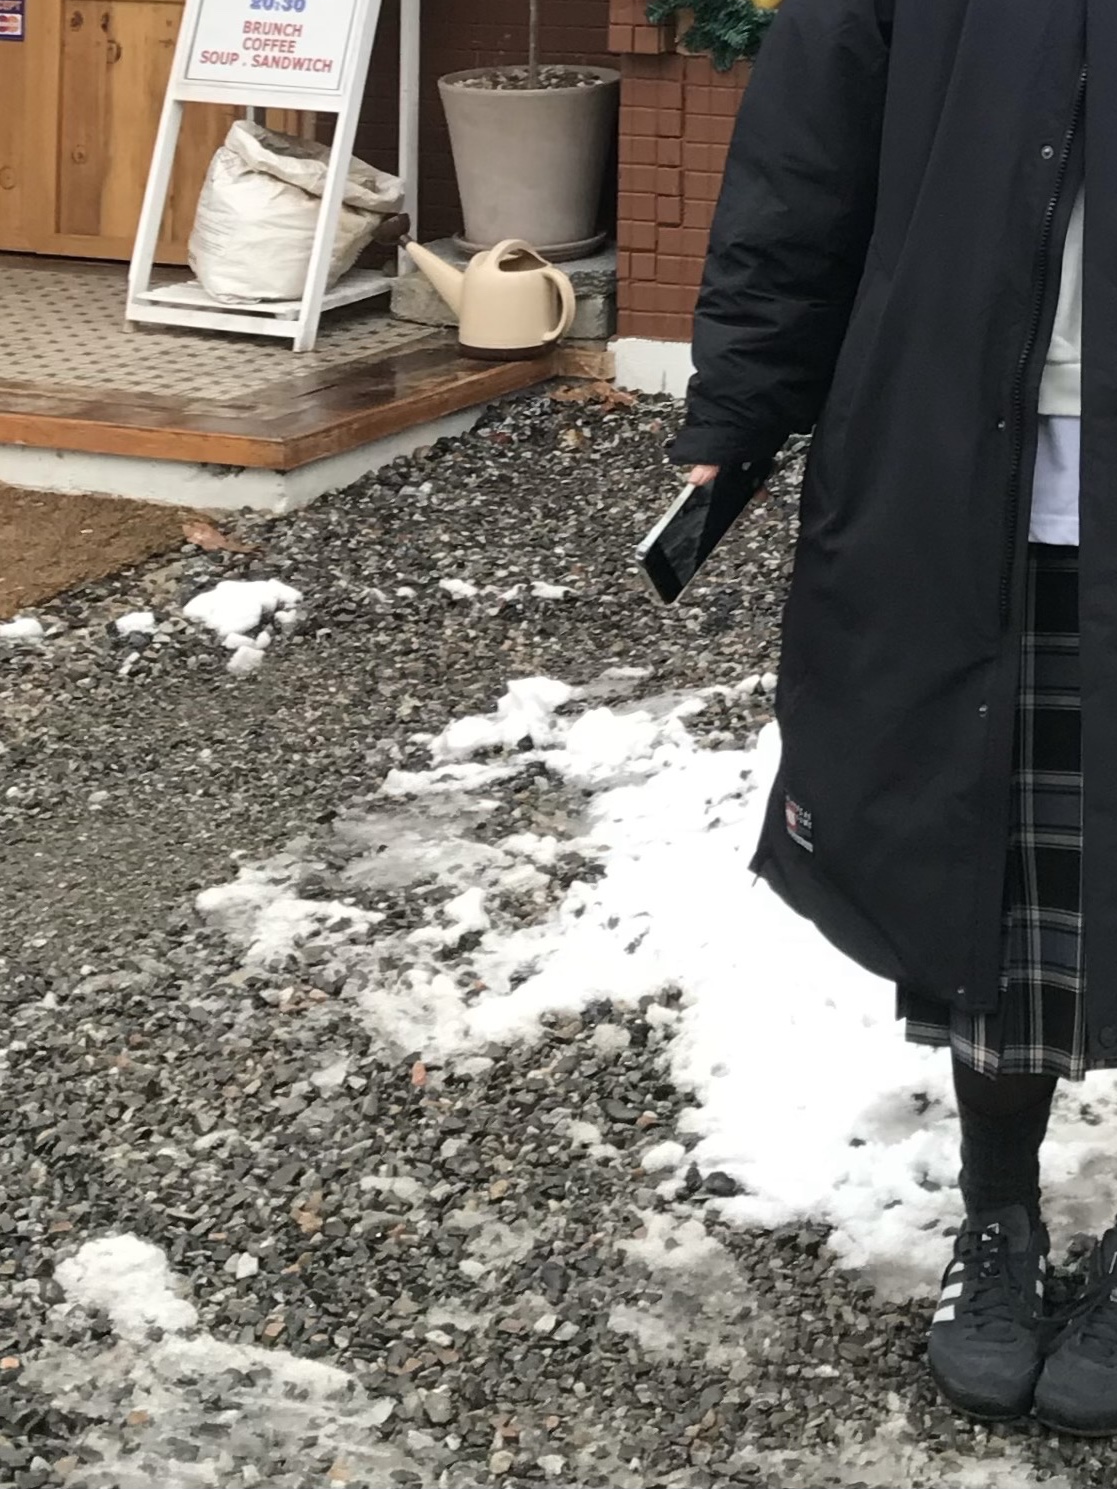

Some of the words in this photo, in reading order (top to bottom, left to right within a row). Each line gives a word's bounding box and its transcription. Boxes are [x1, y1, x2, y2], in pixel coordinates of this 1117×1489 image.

[242, 20, 303, 37] BRUNCH
[242, 37, 297, 54] COFFEE
[199, 50, 240, 66] SOUP
[250, 54, 333, 73] SANDWICH
